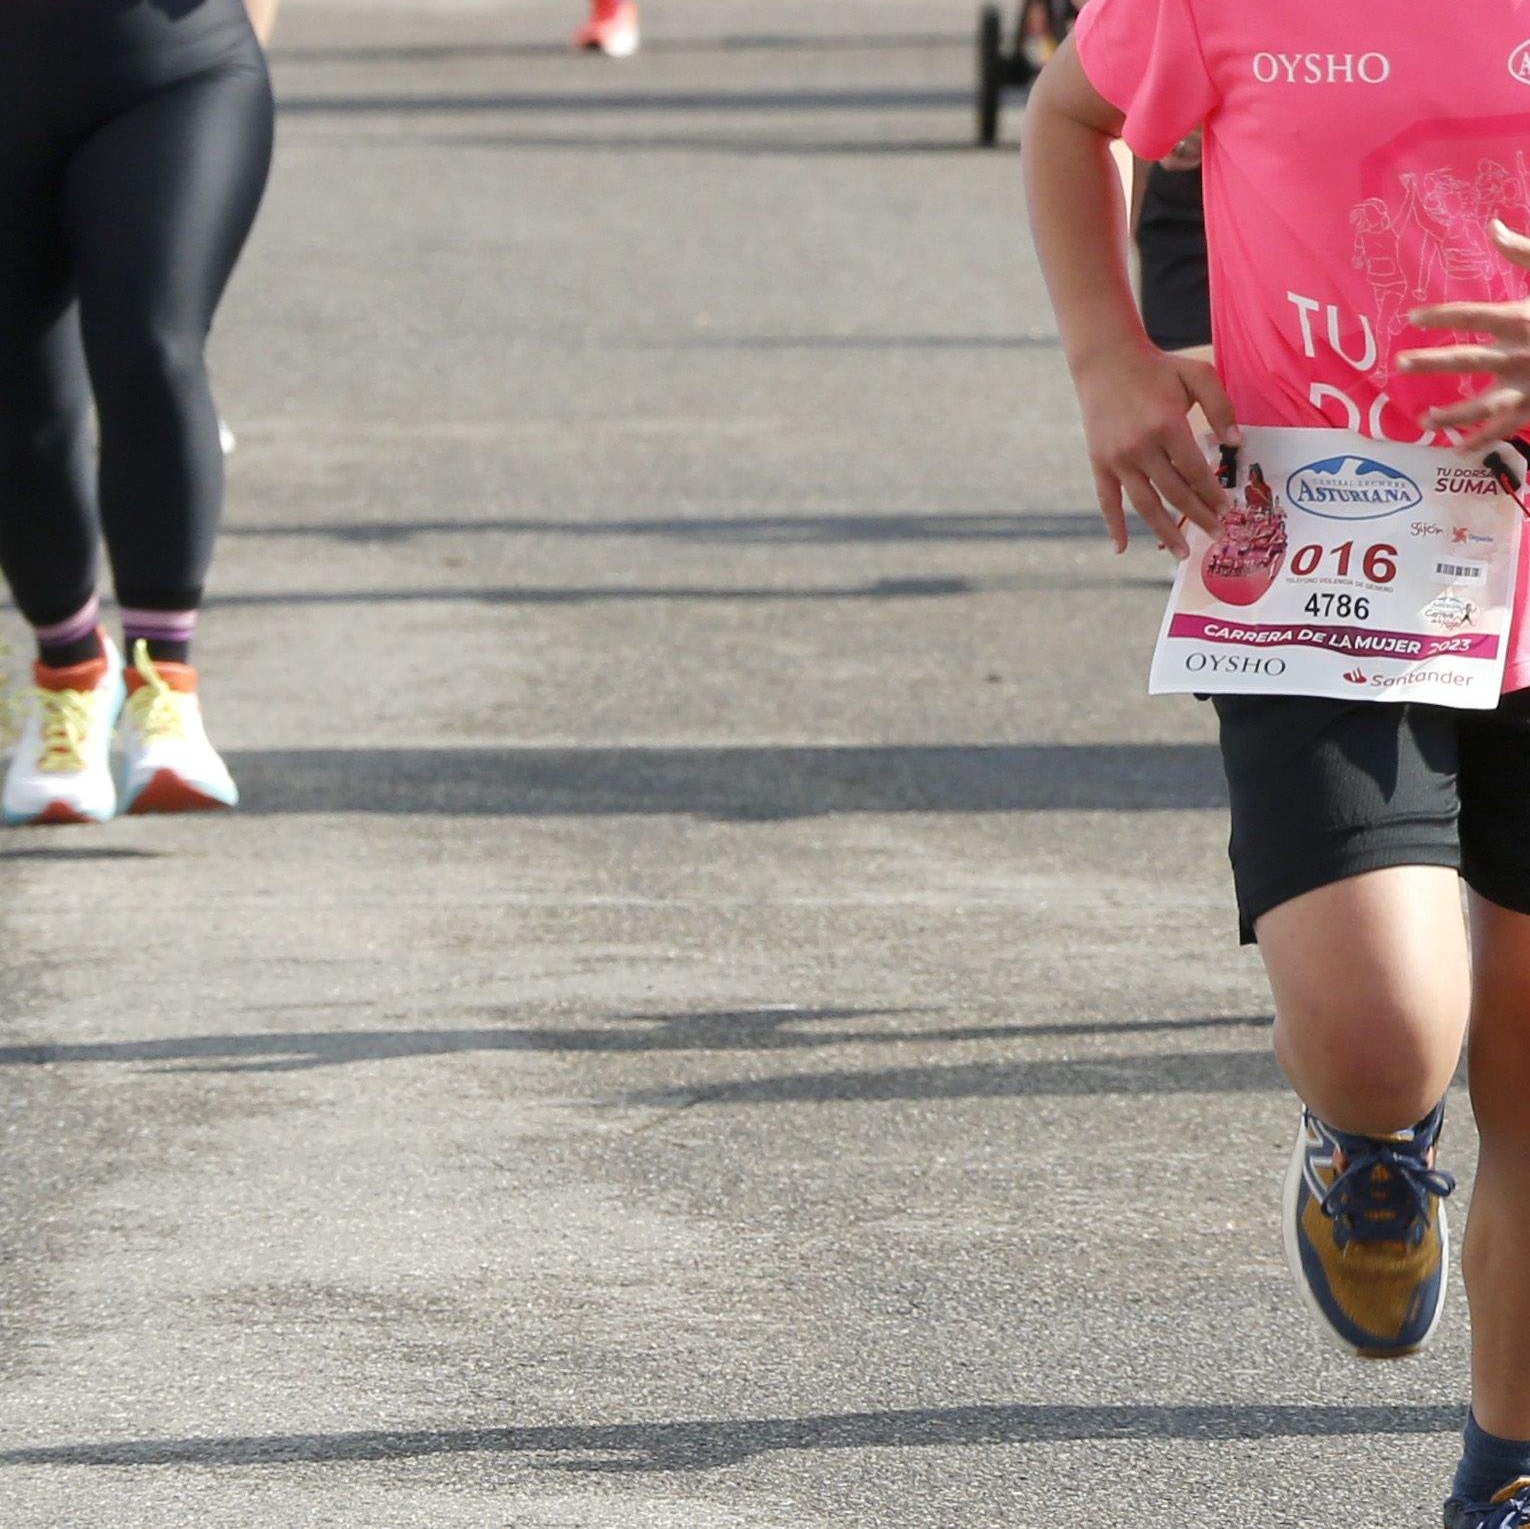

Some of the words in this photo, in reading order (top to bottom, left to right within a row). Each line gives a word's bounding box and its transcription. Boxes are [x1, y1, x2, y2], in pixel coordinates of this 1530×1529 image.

[1252, 51, 1390, 84] OYSHO
[1286, 291, 1377, 371] TU
[1437, 467, 1451, 477] TU
[1453, 468, 1498, 479] DORSA
[1297, 478, 1412, 504] ASTURIANA
[1435, 478, 1499, 496] SUMA
[1290, 540, 1400, 584] 016
[1304, 593, 1371, 620] 4786
[1203, 623, 1293, 643] CARRERA
[1297, 629, 1325, 644] DE
[1328, 633, 1351, 650] LA
[1354, 634, 1422, 655] MUJER
[1427, 637, 1473, 655] 2023
[1185, 652, 1286, 677] OYSHO
[1370, 669, 1475, 688] Santander
